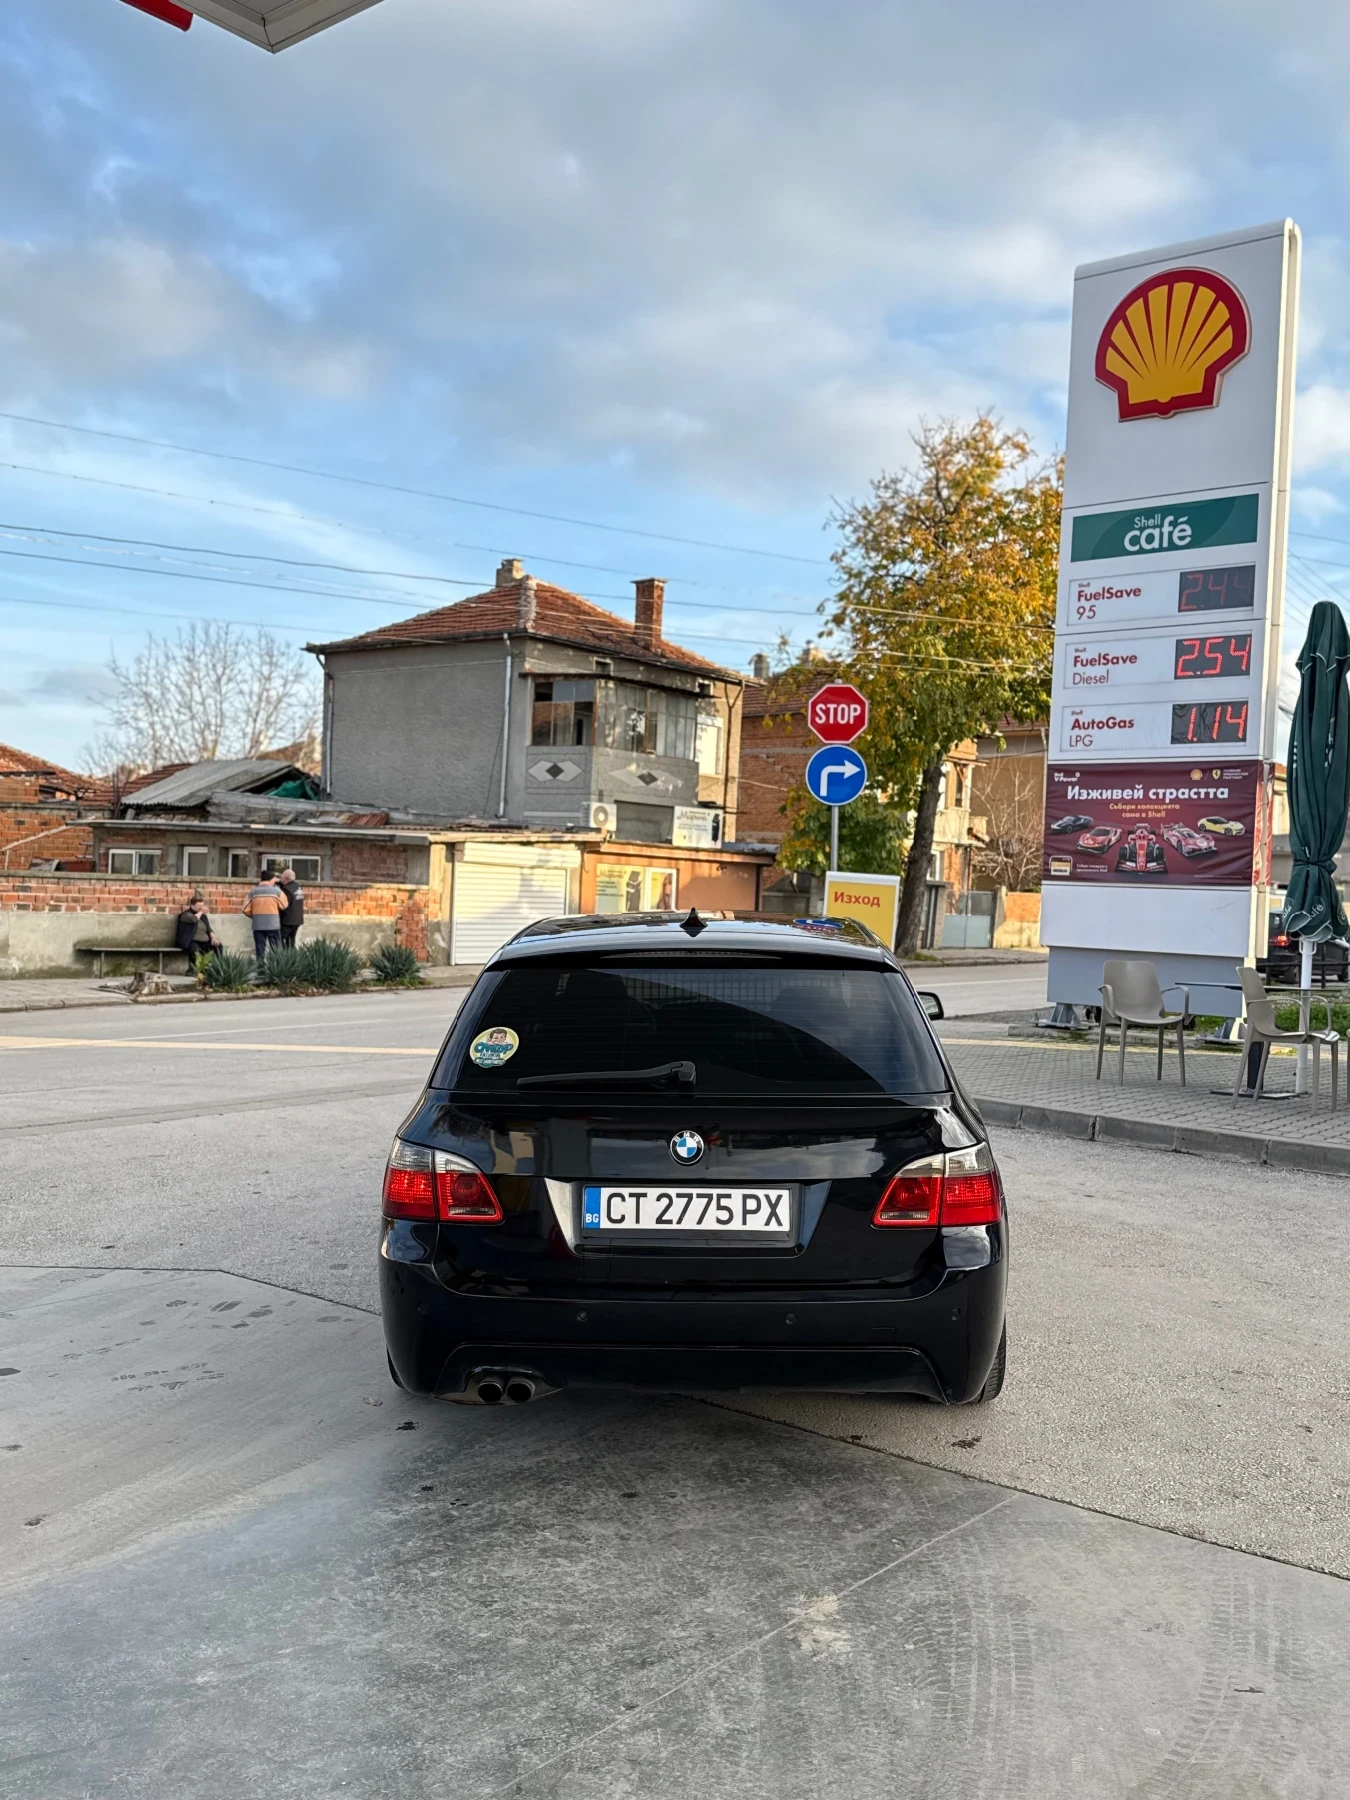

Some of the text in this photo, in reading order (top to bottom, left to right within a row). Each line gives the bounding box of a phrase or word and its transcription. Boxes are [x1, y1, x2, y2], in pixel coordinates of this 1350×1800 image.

[1133, 513, 1161, 528] Shell
[1124, 515, 1192, 552] café
[1077, 587, 1142, 602] FuelSave
[1076, 604, 1096, 620] 95
[1073, 653, 1138, 667] FuelSave
[1177, 637, 1251, 676] 2.54
[1072, 669, 1109, 685] Diesel
[815, 703, 861, 724] STOP
[1070, 716, 1135, 730] AutoGas
[1187, 704, 1247, 741] 1.14
[1069, 734, 1093, 747] LPG
[1067, 784, 1229, 803] Изживей страстта
[1109, 803, 1136, 811] Събери
[834, 890, 881, 908] Изход
[606, 1192, 783, 1227] CT 2775 PX
[585, 1213, 599, 1223] BG
